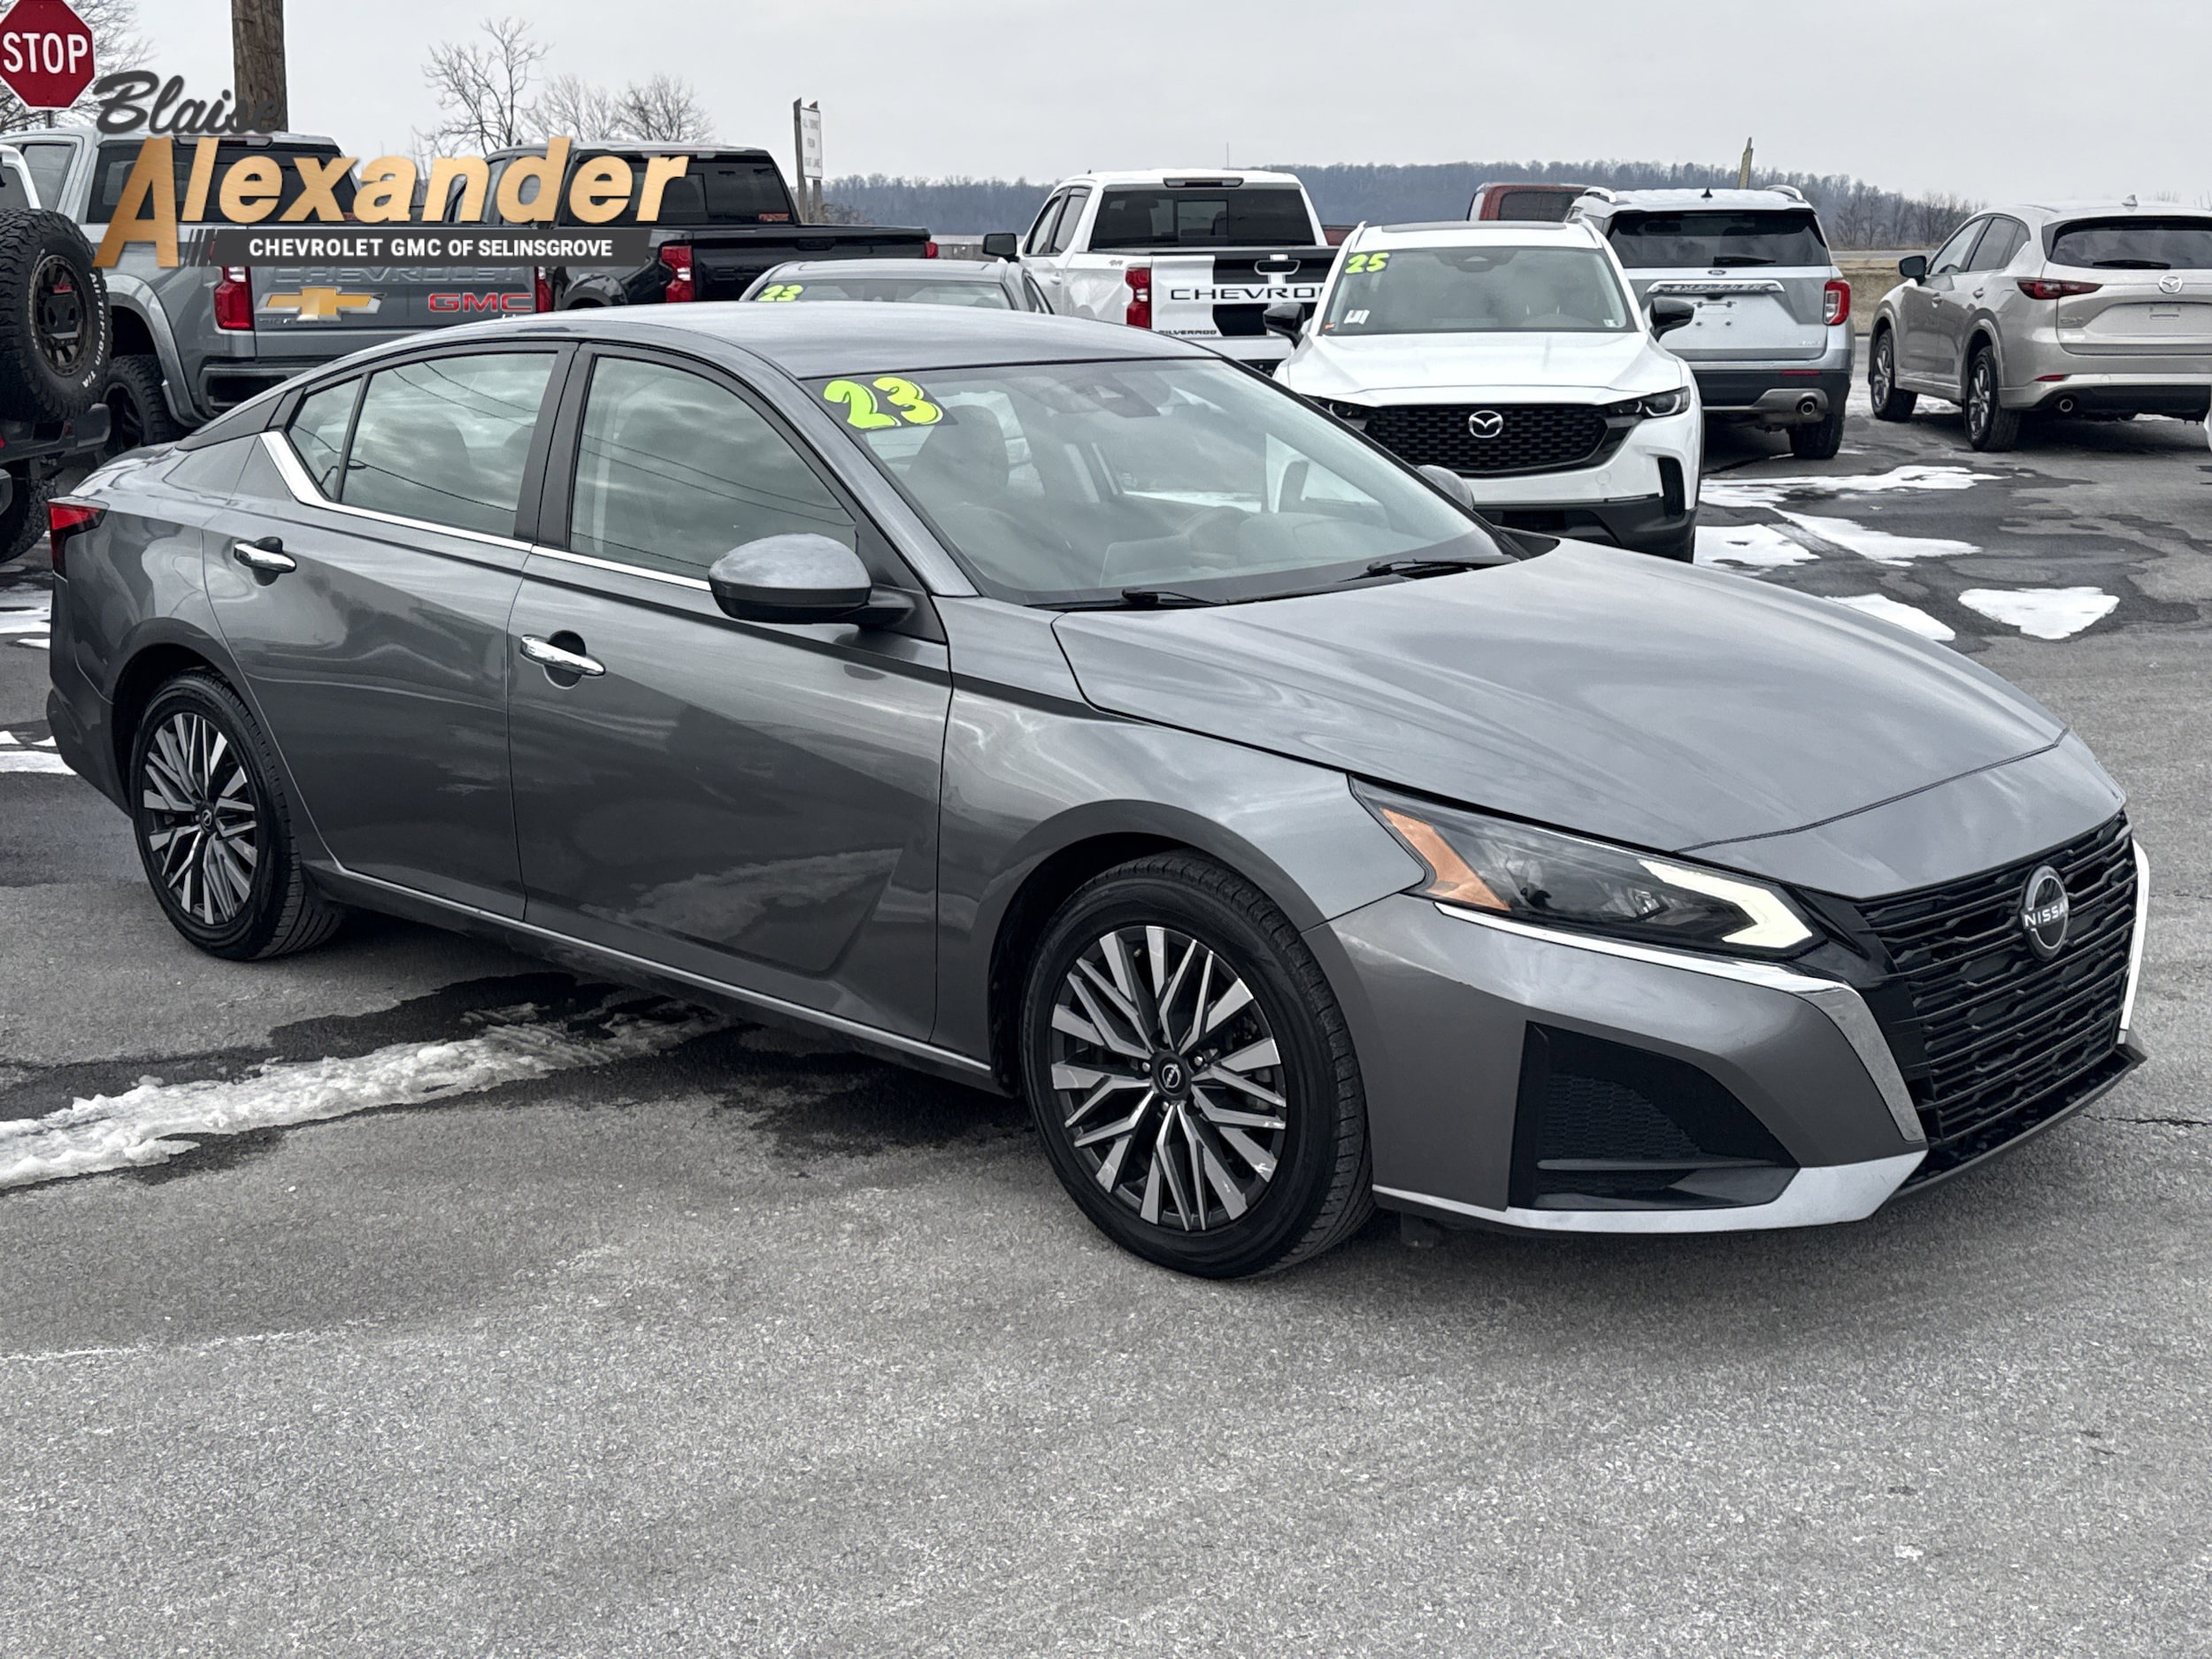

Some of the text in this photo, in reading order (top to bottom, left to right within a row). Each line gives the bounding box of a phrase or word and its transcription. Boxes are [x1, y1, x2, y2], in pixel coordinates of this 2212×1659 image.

[3, 32, 88, 74] STOP
[1345, 253, 1390, 273] 25
[275, 266, 522, 282] CHEVROLET
[428, 292, 533, 312] GMC
[757, 285, 803, 301] 23
[824, 377, 943, 430] 23
